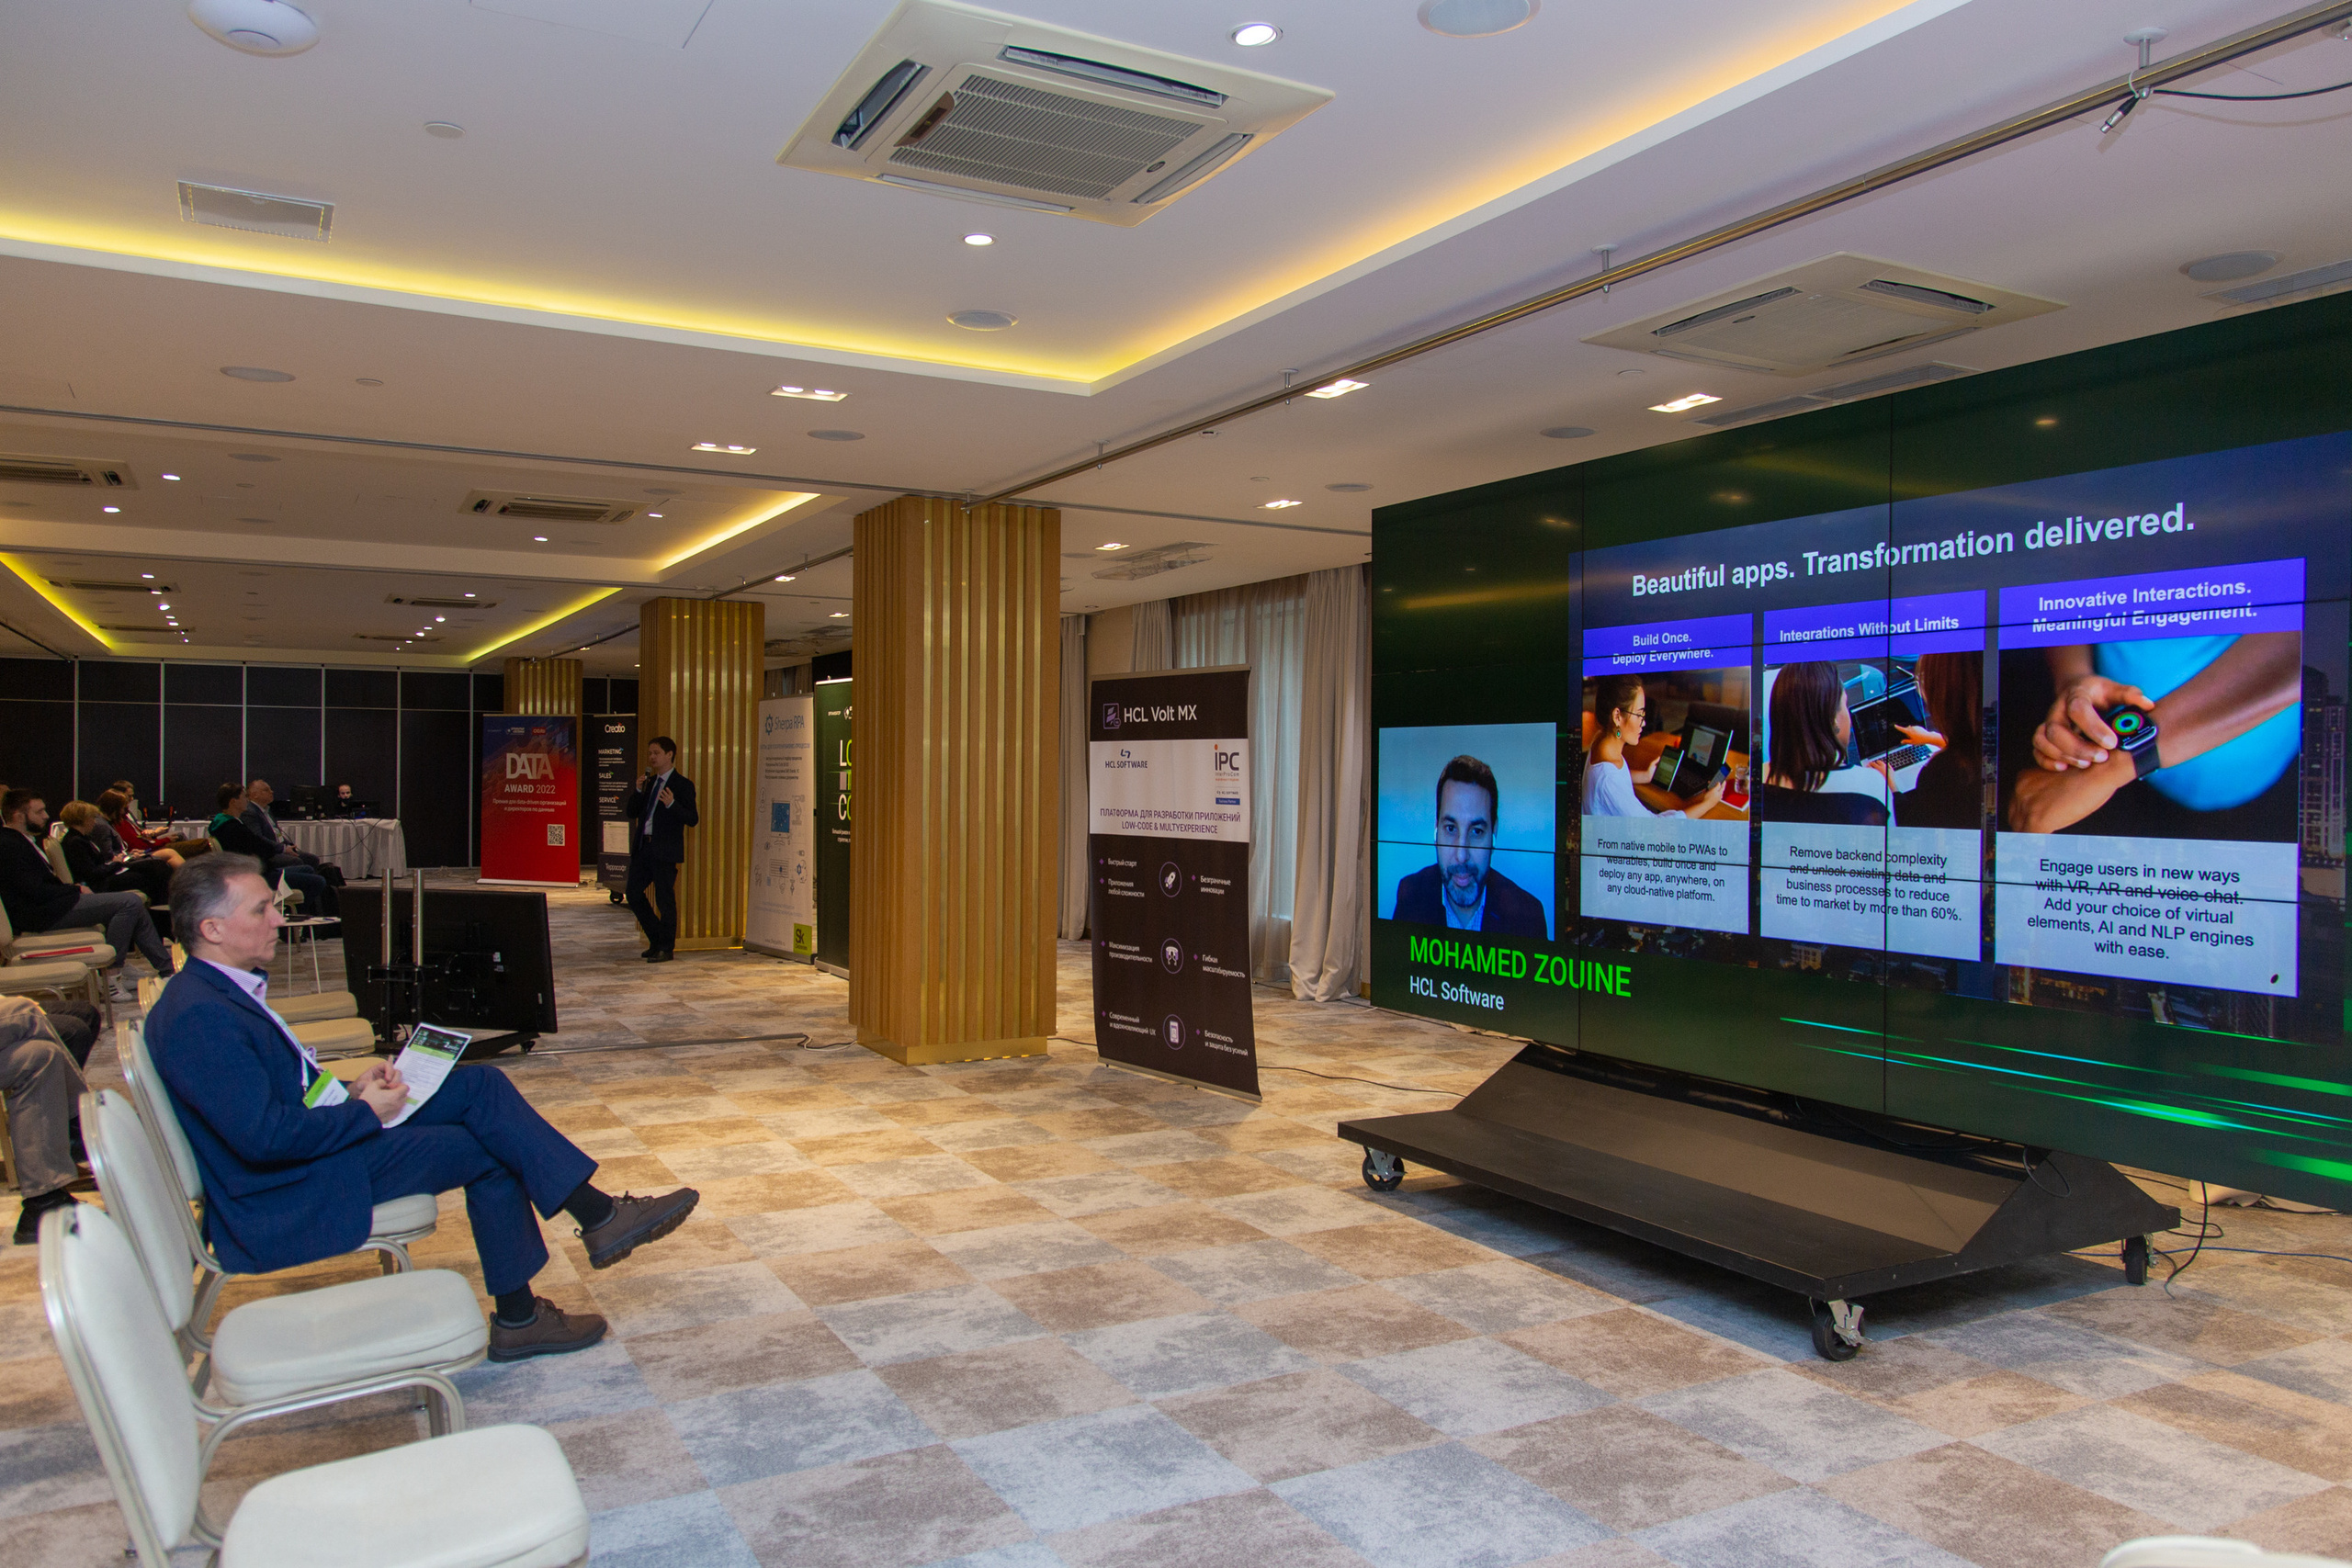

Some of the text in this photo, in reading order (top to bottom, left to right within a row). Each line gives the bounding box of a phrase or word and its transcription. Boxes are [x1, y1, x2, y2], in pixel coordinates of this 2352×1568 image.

[1633, 502, 2195, 596] Beautiful apps. Transformation delivered.
[2039, 581, 2251, 611] Innovative Interactions.
[2031, 603, 2257, 633] Meaningful Engagement.
[1633, 633, 1692, 647] Build Once.
[1780, 616, 1960, 644] Integrations Without Limits
[1612, 648, 1713, 666] Deploy Everywhere.
[775, 716, 805, 733] Sherpa RPA
[1124, 705, 1197, 723] HCL Volt MX
[506, 753, 554, 780] DATA
[1117, 761, 1148, 769] SOFTWARE
[504, 784, 556, 794] AWARD 2022
[1100, 808, 1240, 822] ПЛАТФОРМА ДЛЯ РАЗРАБОТКИ ПРИЛОЖЕНИЙ
[1122, 821, 1218, 834] LOW-CODE & MULTYEXPERIENCE
[1598, 839, 1728, 856] From native mobile to PWAs to
[1790, 846, 1948, 868] Remove backend complexity
[1606, 855, 1716, 871] wearables, build once and
[1790, 863, 1946, 884] and unlock existing data and
[2040, 858, 2240, 886] Engage users in new ways
[1599, 868, 1725, 887] deploy any app, anywhere, on
[1607, 884, 1715, 902] any cloud-native platform.
[1786, 878, 1950, 902] business processes to reduce
[2035, 878, 2244, 905] with VR, AR and voice chat.
[1776, 894, 1962, 920] time to market by more than 60%.
[2043, 897, 2233, 924] Add your choice of virtual
[2027, 916, 2254, 947] elements, AI and NLP engines
[2095, 940, 2169, 959] with ease.
[1410, 935, 1632, 998] MOHAMED ZOUINE
[1409, 976, 1505, 1010] HCL Software
